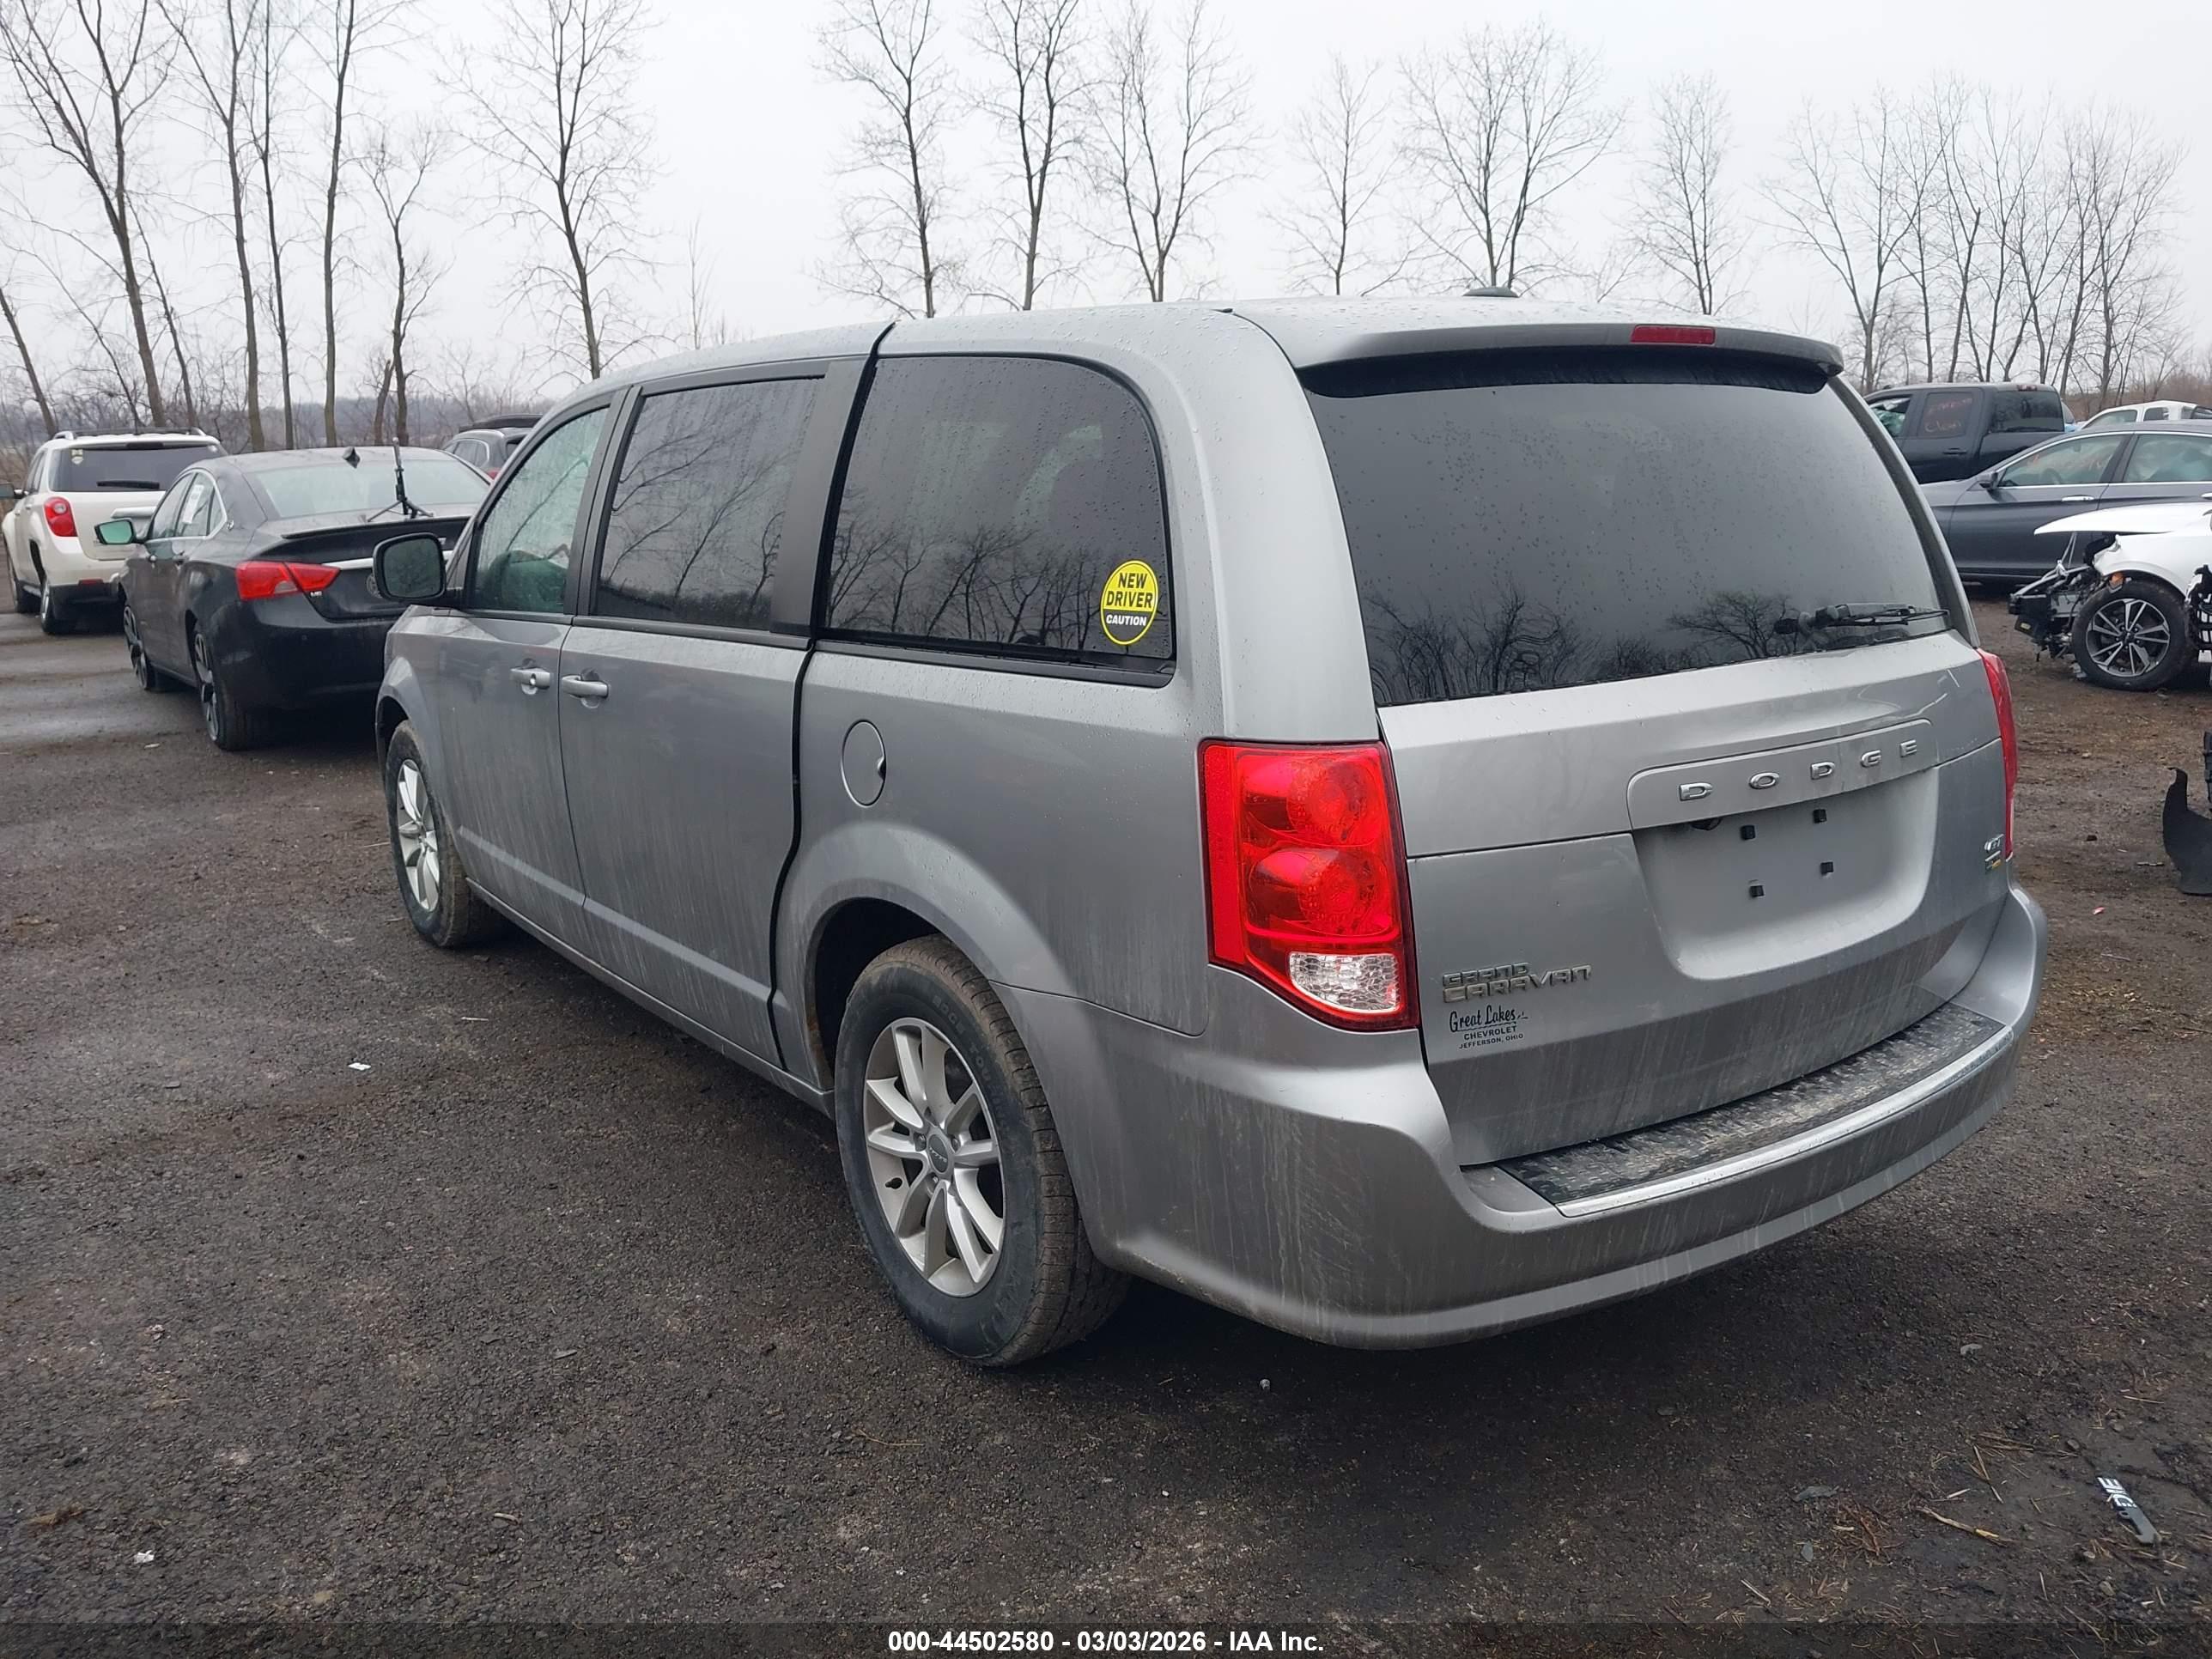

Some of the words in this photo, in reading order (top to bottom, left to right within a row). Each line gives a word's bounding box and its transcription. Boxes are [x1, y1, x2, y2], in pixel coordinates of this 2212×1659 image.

[1118, 572, 1148, 589] NEW
[1105, 590, 1153, 609] DRIVER
[1105, 614, 1148, 627] CAUTION
[1679, 739, 1917, 801] DODGE
[1443, 962, 1530, 988] GRAND
[1443, 964, 1592, 1003] CARAVAN
[1449, 1009, 1482, 1033] Great
[1485, 1004, 1516, 1025] Lakes
[1463, 1025, 1517, 1041] CHEVROLET
[1505, 1033, 1524, 1042] OHIO
